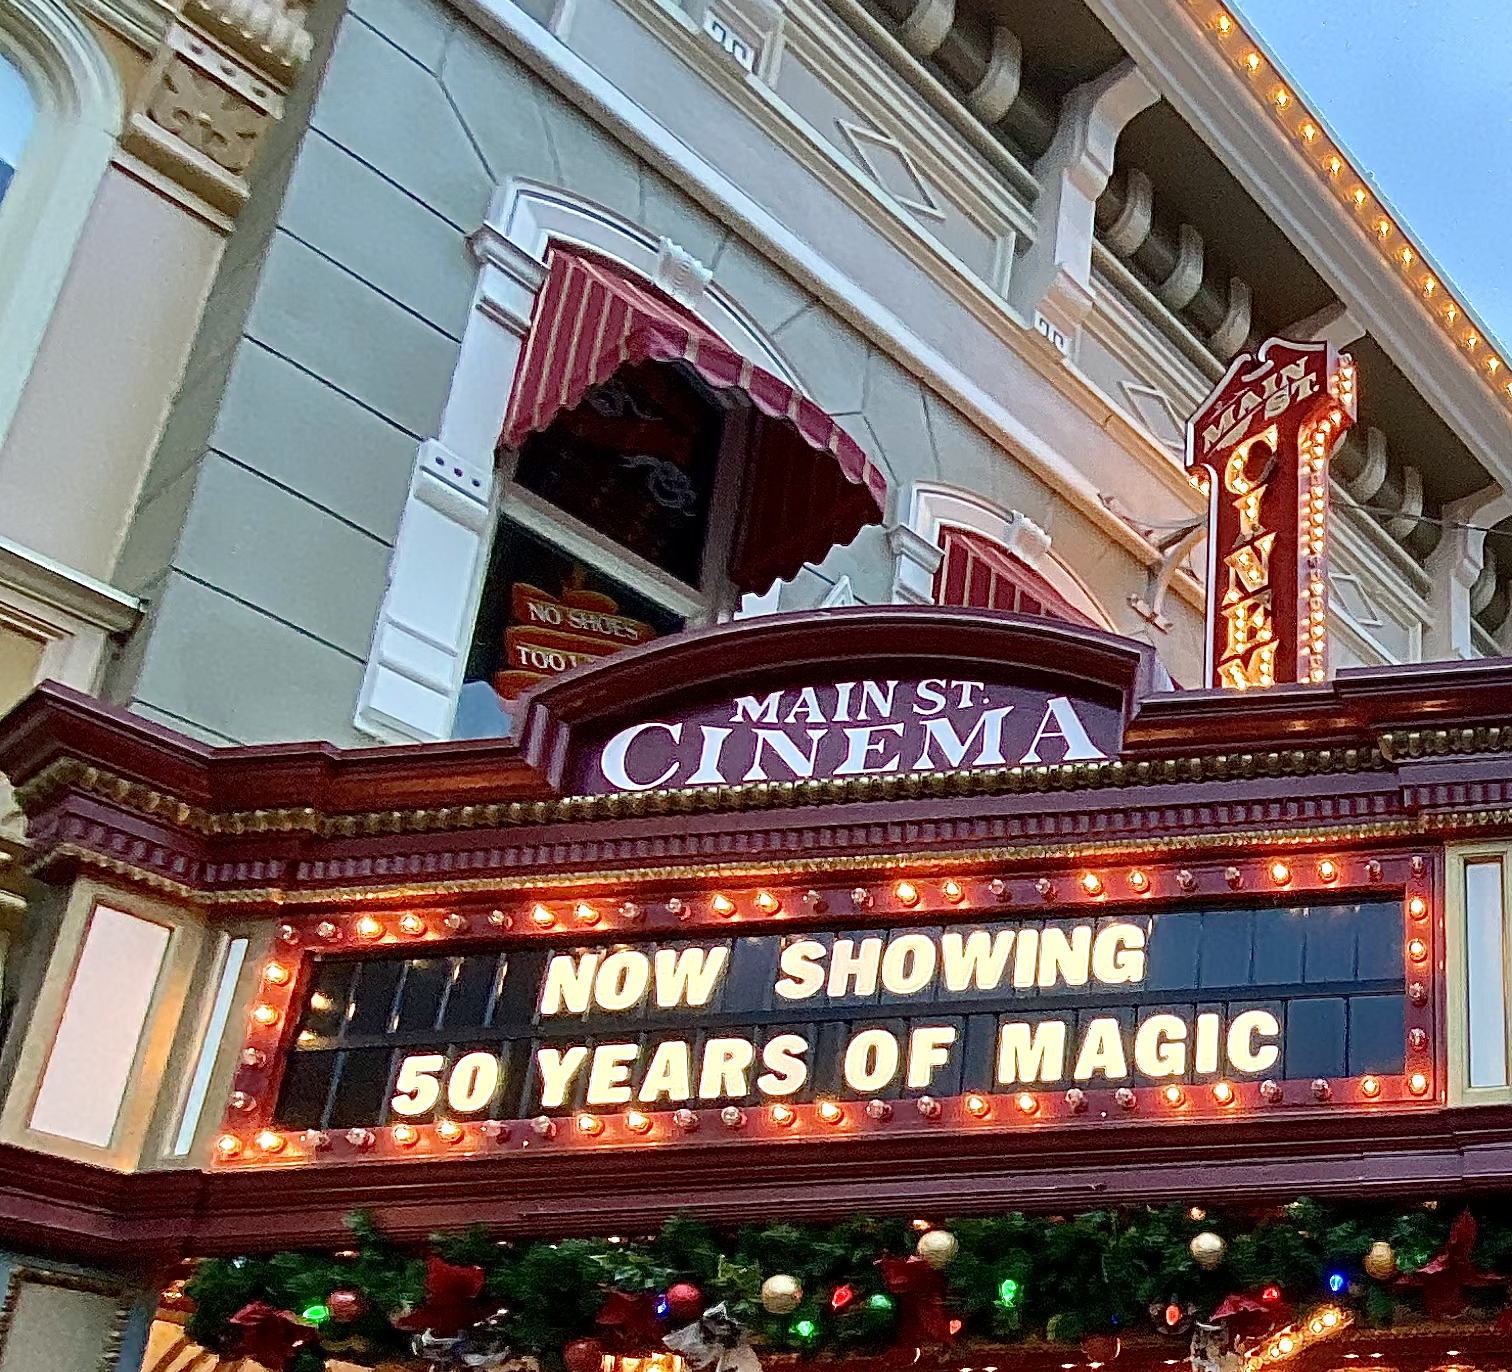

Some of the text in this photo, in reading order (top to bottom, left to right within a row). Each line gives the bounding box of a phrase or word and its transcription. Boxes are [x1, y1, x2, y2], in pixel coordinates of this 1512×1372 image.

[1202, 356, 1321, 455] MAIN ST.
[516, 645, 566, 672] TOO
[526, 602, 638, 641] NO SHOES
[600, 695, 1109, 792] CINEMA
[729, 678, 990, 724] MAIN ST.
[541, 923, 1146, 1015] NOW SHOWING
[391, 1010, 1279, 1116] 50 YEARS OF MAGIC
